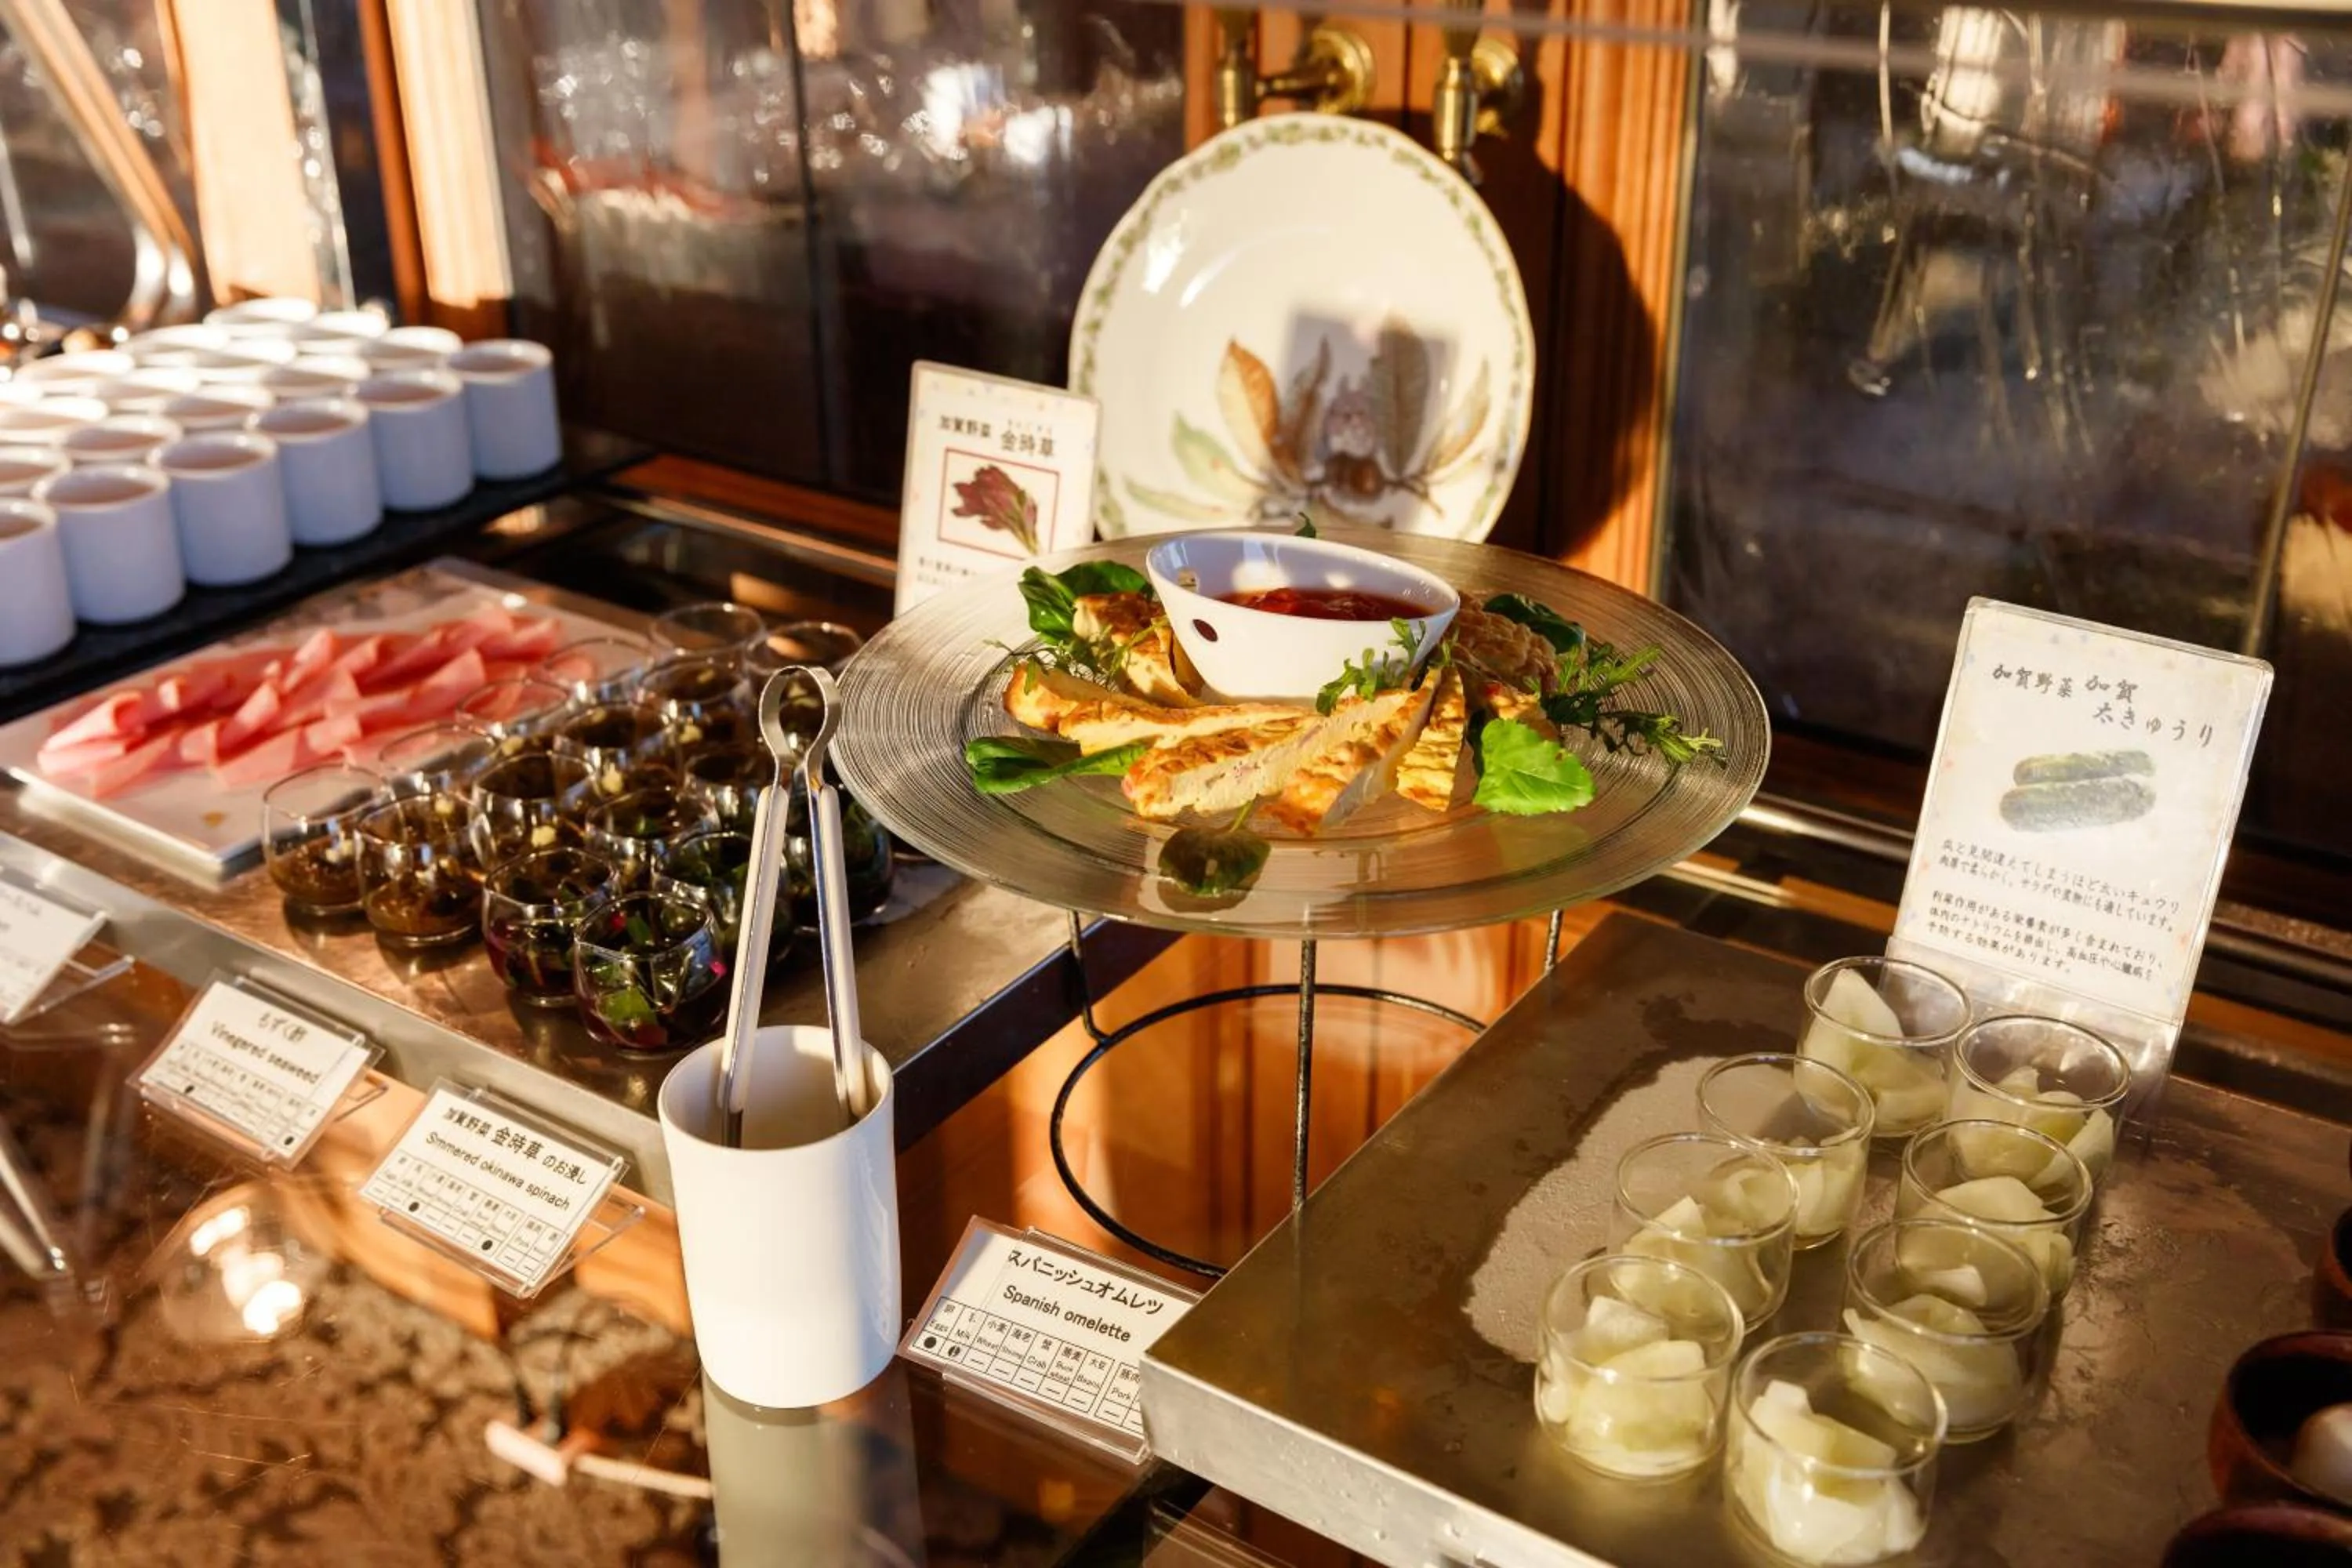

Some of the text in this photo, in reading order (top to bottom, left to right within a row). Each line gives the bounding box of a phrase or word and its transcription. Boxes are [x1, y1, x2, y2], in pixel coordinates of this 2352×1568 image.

[1992, 664, 2138, 703] 加賀野菜 加賀
[2092, 702, 2213, 748] 太きゅうり
[211, 1019, 269, 1058] Vinegared
[267, 1053, 321, 1084] seaweed
[426, 1131, 482, 1167] Simmered
[480, 1160, 525, 1189] okinawa
[526, 1183, 571, 1211] spinach
[444, 1107, 587, 1185] 加賀野菜 金時草 のお浸し
[1007, 1250, 1164, 1316] スパニッシュオムレツ
[1004, 1285, 1131, 1343] Spanish omelette
[1027, 1356, 1047, 1370] Crab
[1111, 1387, 1131, 1400] Pork
